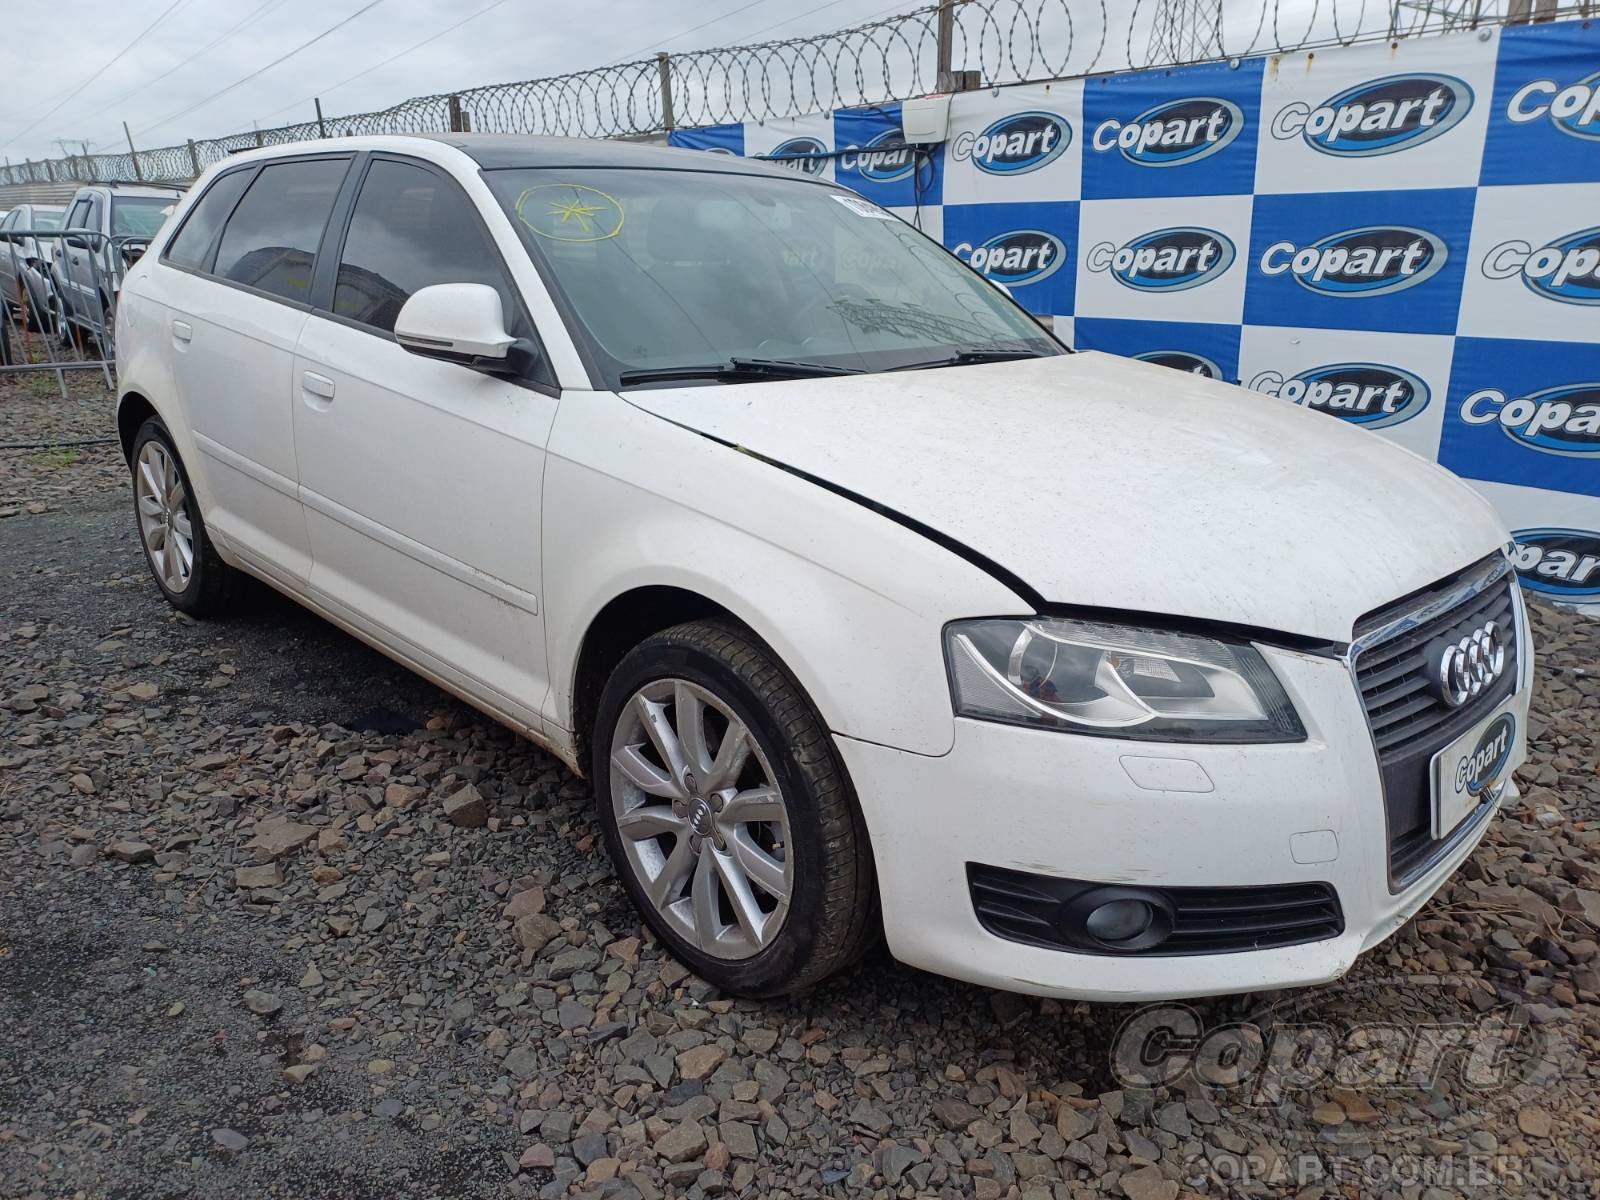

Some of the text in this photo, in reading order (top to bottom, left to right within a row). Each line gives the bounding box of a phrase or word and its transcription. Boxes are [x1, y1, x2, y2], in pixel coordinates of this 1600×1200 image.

[1092, 104, 1228, 154] Copart
[1271, 82, 1447, 144] Copart
[952, 120, 1056, 165] Copart
[1086, 237, 1219, 278] Copart
[1260, 236, 1425, 284] Copart
[1249, 371, 1406, 413] Copart
[1455, 724, 1508, 794] Copart
